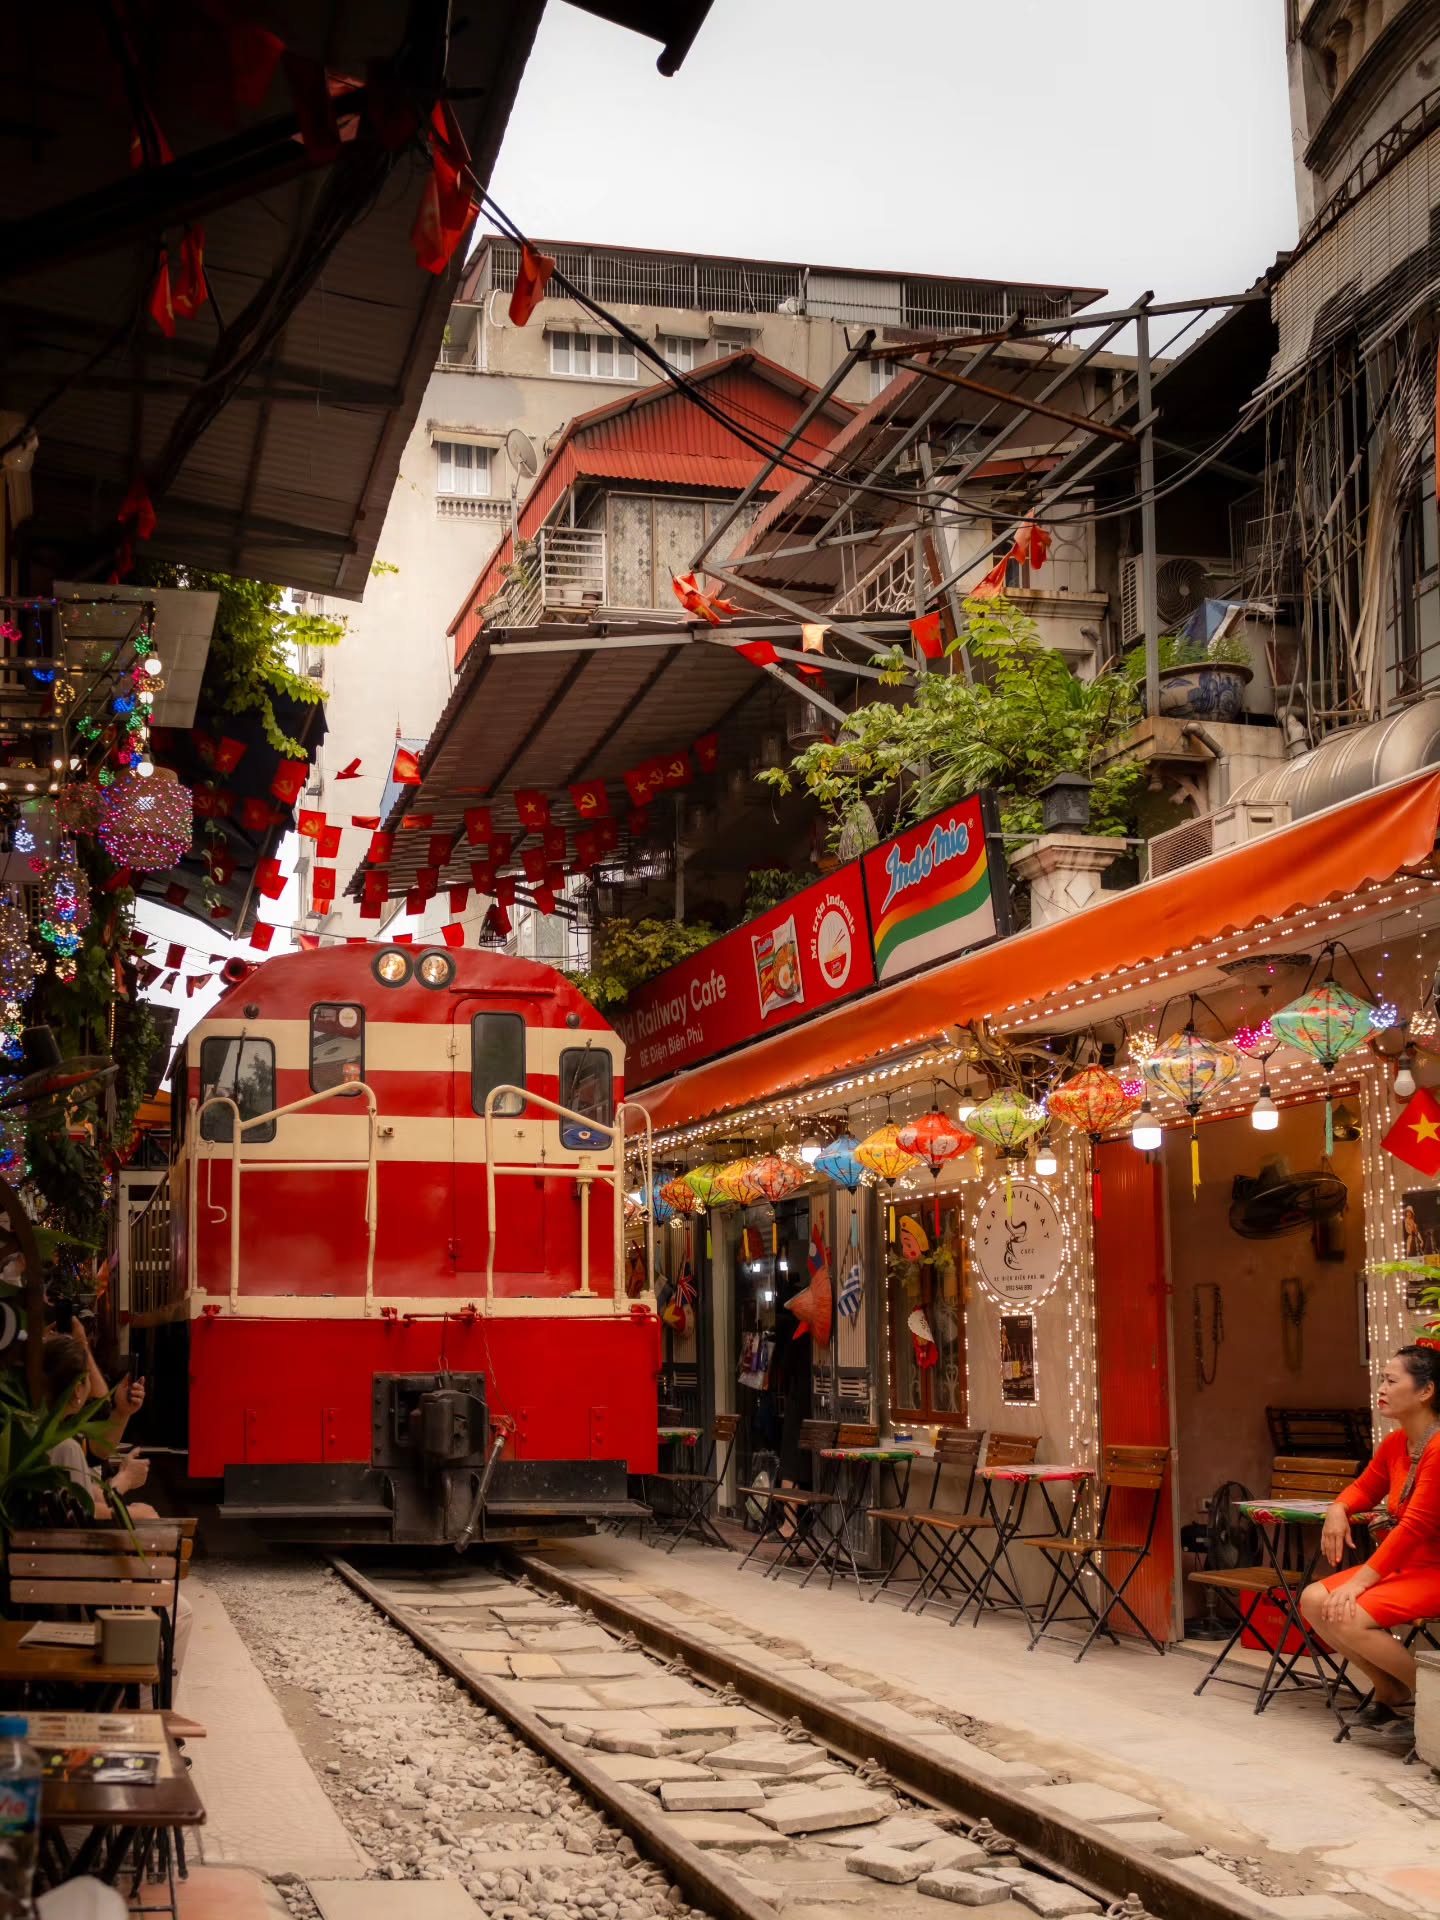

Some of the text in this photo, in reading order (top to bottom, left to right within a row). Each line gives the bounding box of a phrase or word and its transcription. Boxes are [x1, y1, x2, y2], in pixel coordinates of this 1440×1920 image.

[636, 993, 687, 1039] Railway
[690, 968, 727, 1012] Cafe
[668, 1033, 687, 1056] Biên
